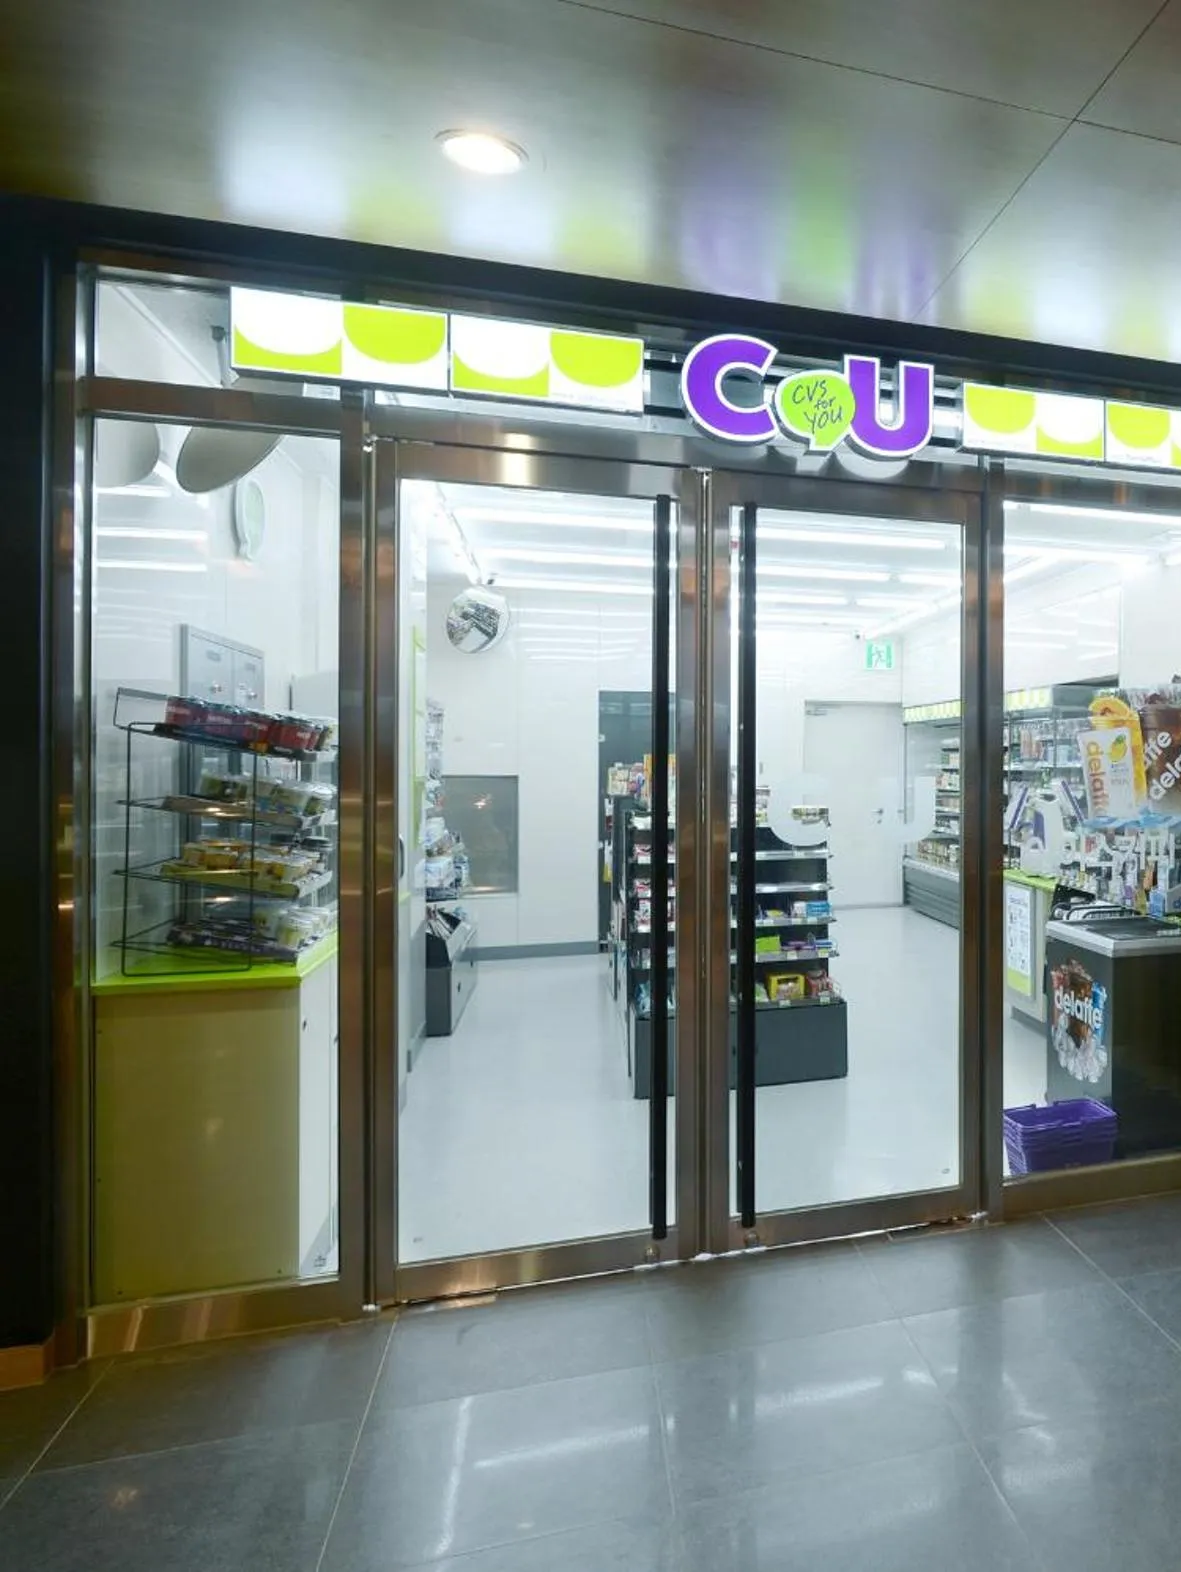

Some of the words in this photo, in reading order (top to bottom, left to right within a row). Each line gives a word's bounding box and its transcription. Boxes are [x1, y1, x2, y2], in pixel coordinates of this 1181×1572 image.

[791, 379, 828, 405] CVS
[814, 397, 837, 411] for
[803, 406, 843, 435] YOU
